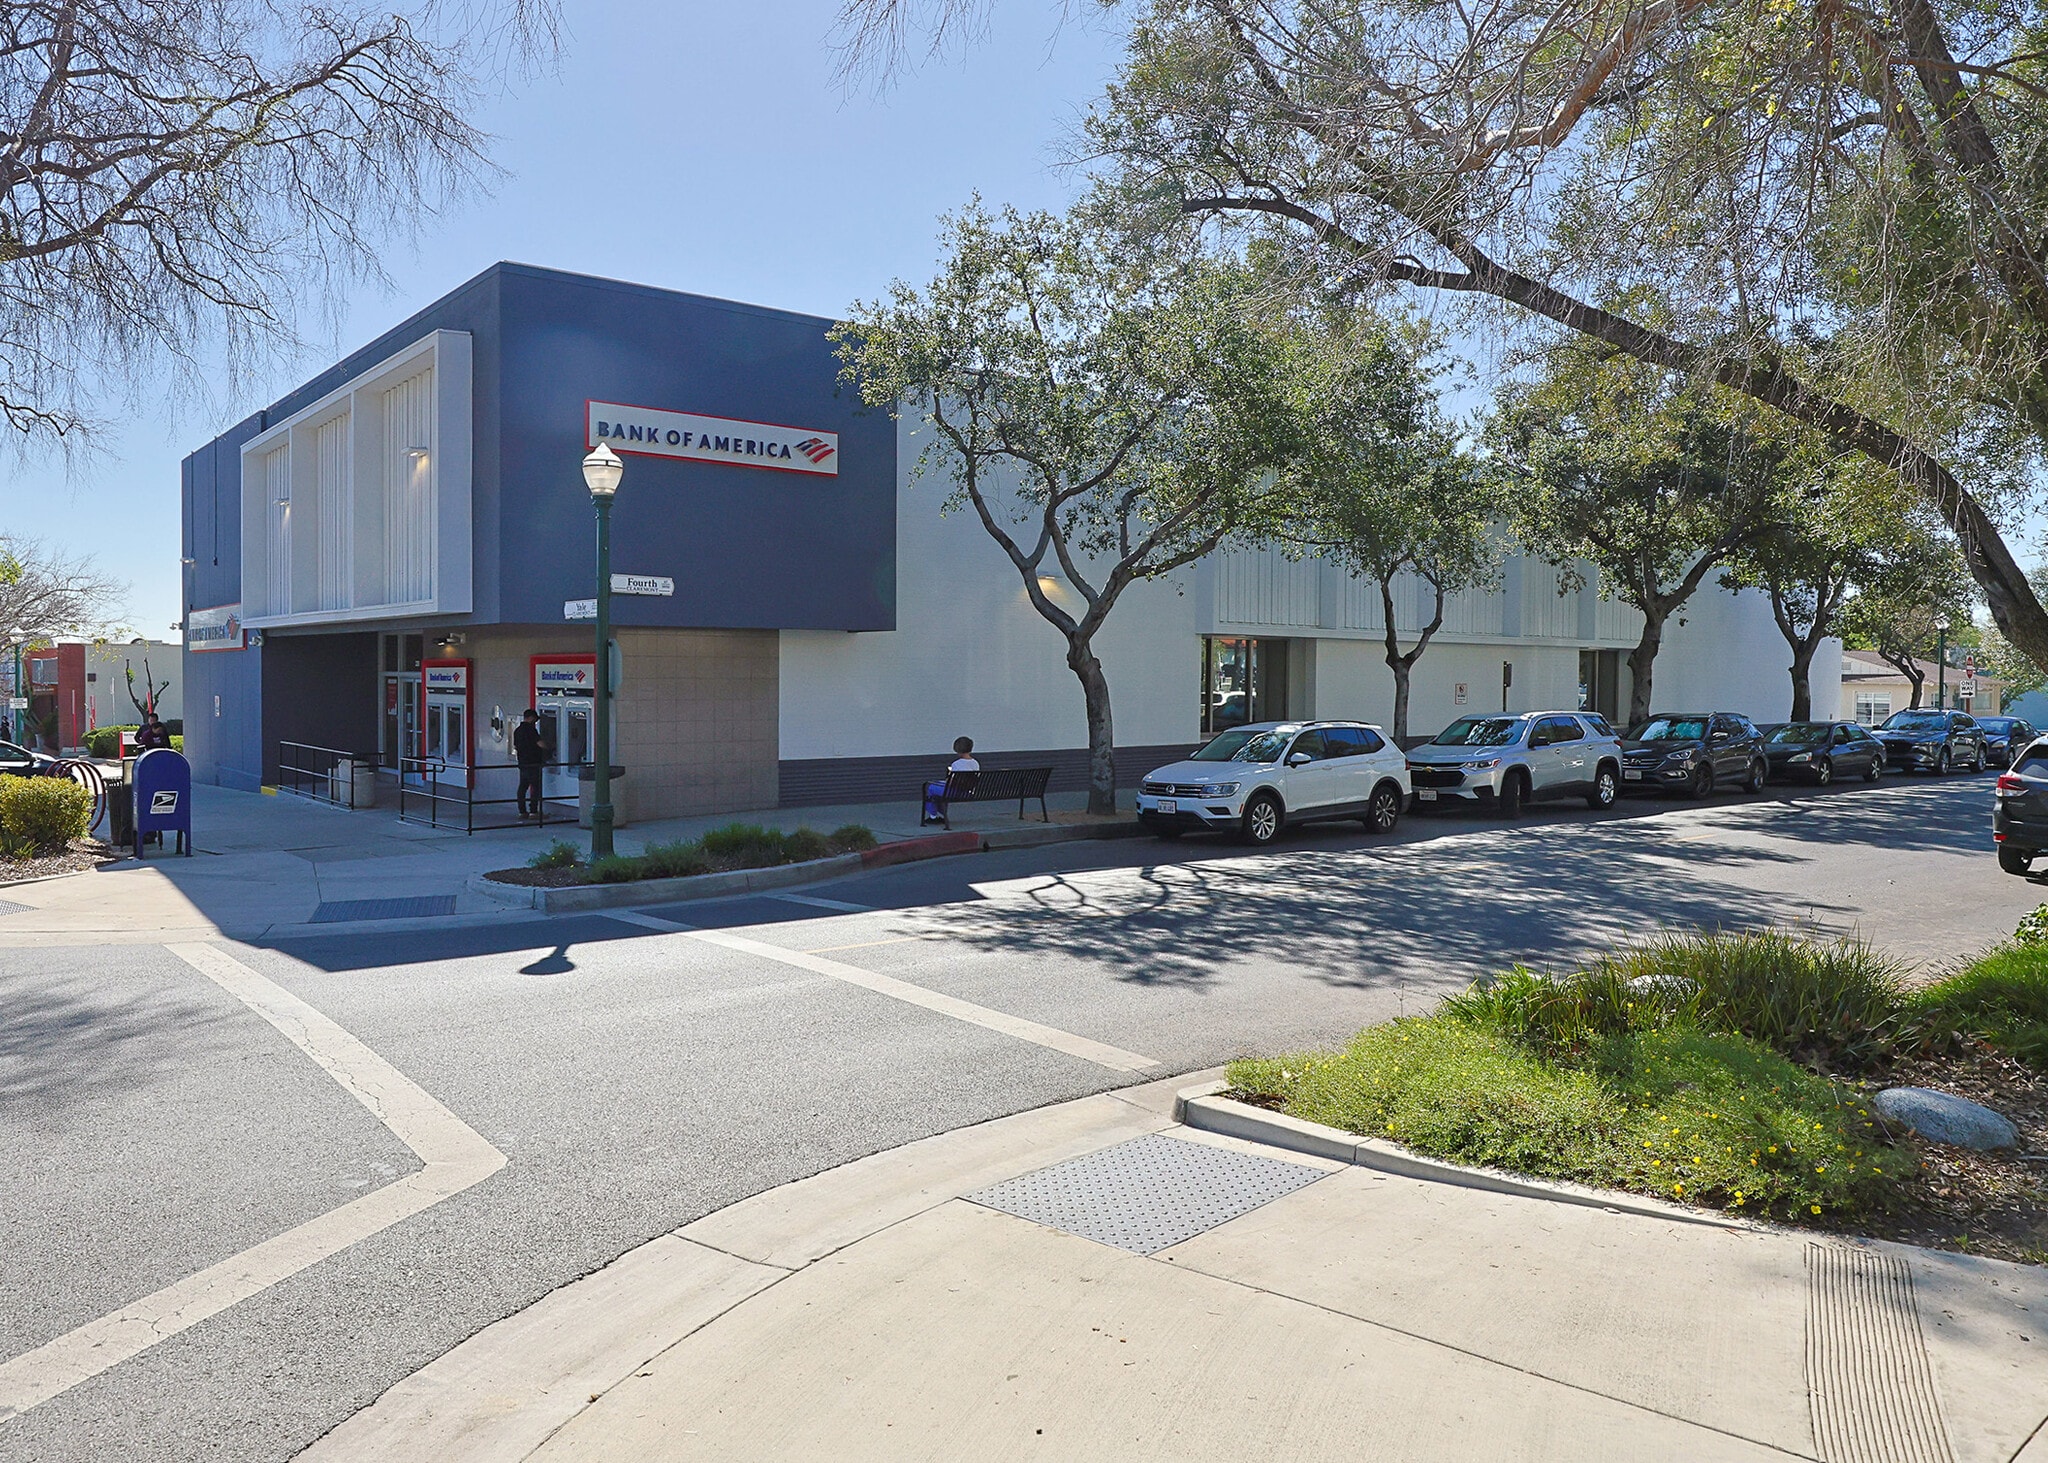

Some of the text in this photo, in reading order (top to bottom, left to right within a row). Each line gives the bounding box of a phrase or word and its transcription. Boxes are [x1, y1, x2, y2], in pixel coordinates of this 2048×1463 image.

[597, 421, 792, 460] BANK OF AMERICA
[627, 577, 658, 588] Fourth
